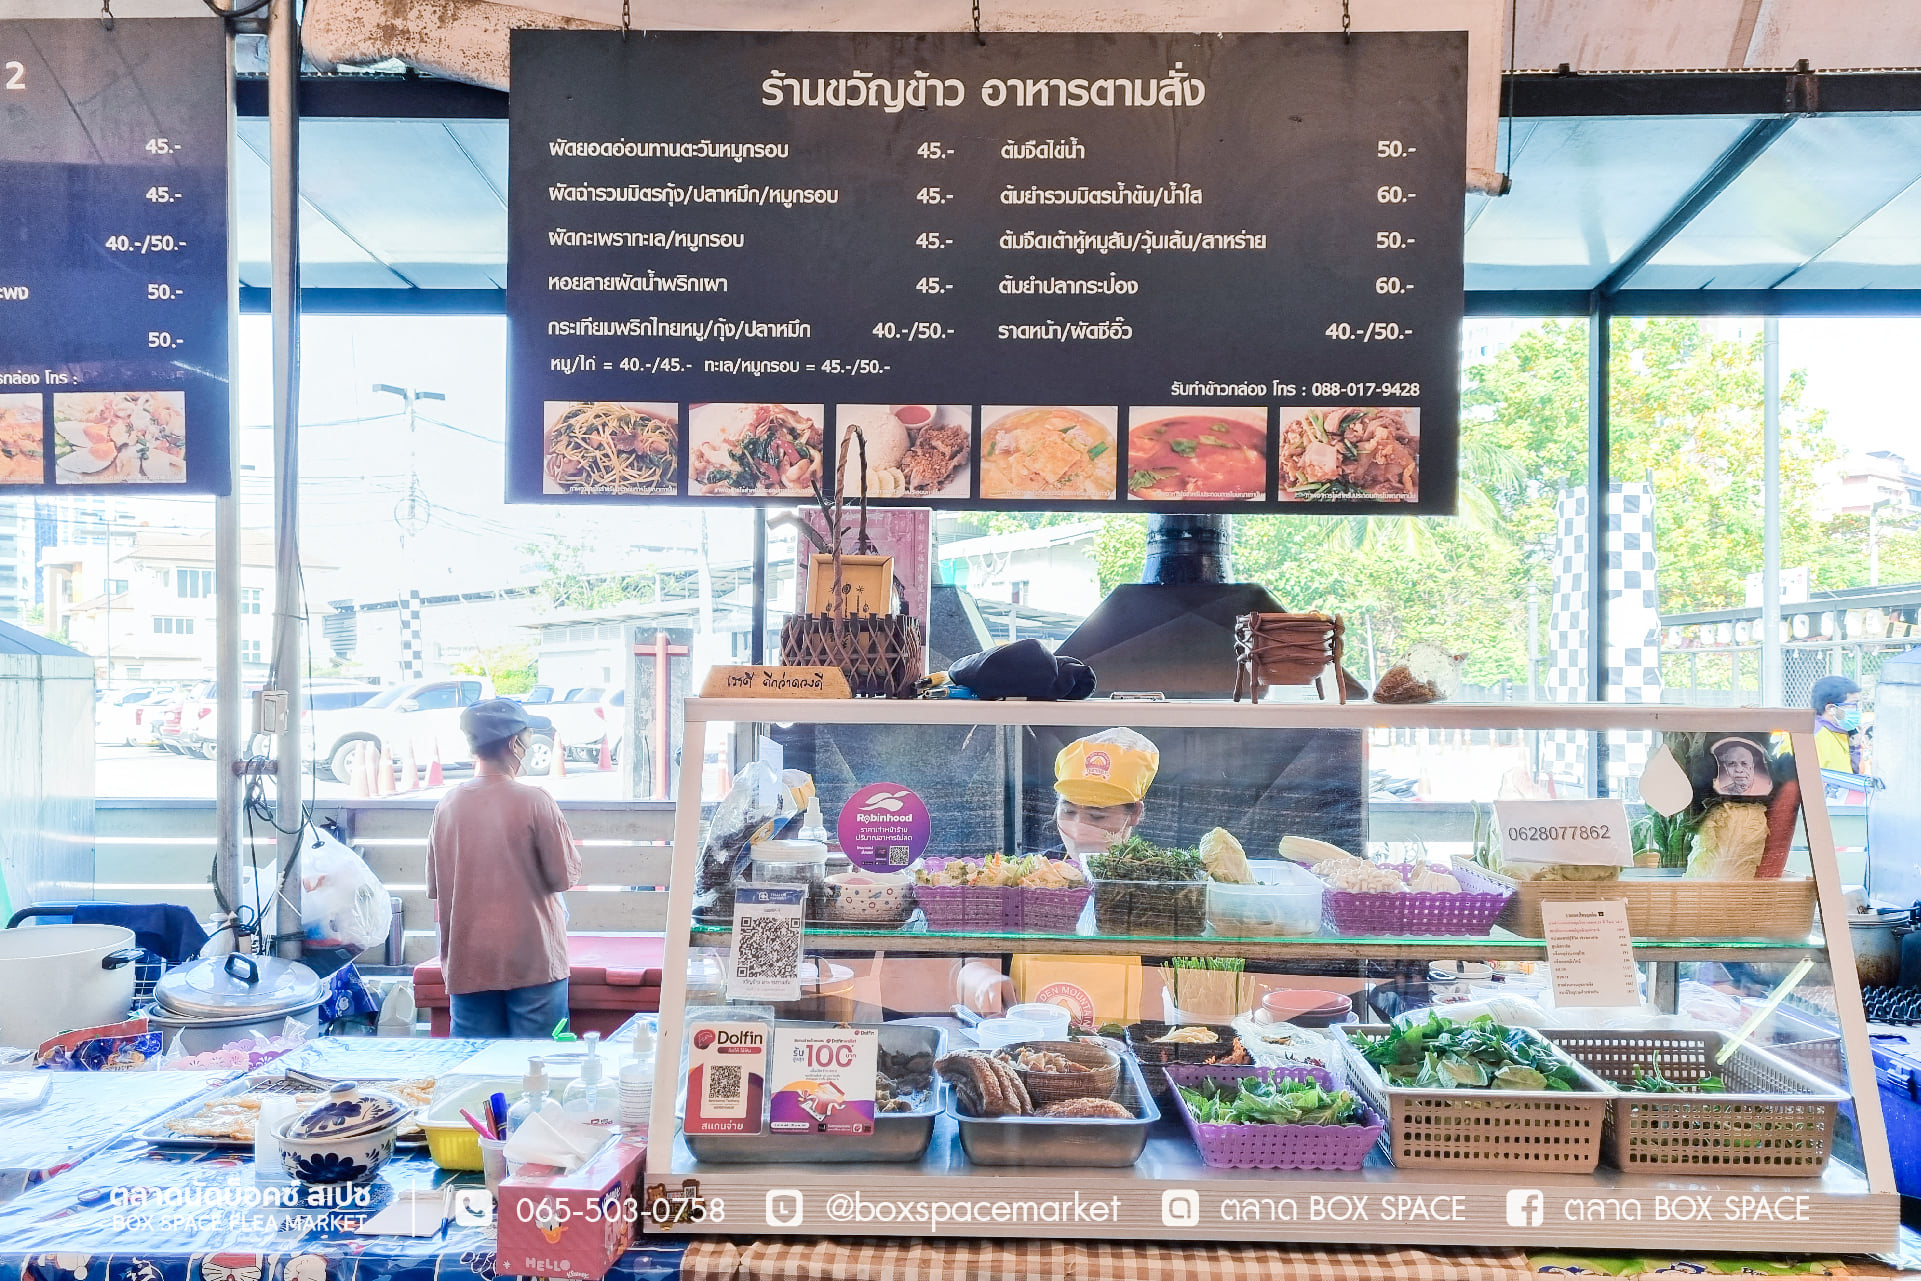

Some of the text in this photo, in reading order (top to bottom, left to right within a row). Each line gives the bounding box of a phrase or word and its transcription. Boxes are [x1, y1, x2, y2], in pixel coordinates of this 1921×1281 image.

[5, 60, 26, 90] 2
[761, 60, 1207, 114] ร้านขวัญข้าว อาหารตามสั่ง
[145, 138, 183, 156] 45.-
[548, 137, 956, 163] ผัดยอดอ่อนทานตะวันหมูกรอบ 45.-
[1000, 136, 1418, 160] ต้มจืดไข่น้ำ 50.-
[145, 186, 183, 204] 45.-
[548, 182, 955, 209] ผัดฉ่ารวมมิตรกุ้ง/ปลาหมึก/หมูกรอบ 45.-
[1000, 181, 1418, 208] ต้มยำรวมมิตรน้ำข้น/น้ำใส 60.-
[105, 234, 188, 255] 40.-/50.-
[548, 227, 954, 252] ผัดกะเพราทะเล/หมูกรอบ 45.-
[999, 229, 1417, 255] ต้มจืดเต้าหู้หมูสับ/วุ้นเส้น/สาหร่าย 50.-
[146, 283, 185, 301] 50.-
[548, 269, 955, 295] หอยลายผัดน้ำพริกเผา 45.-
[998, 271, 1416, 296] ต้มยำปลากระป๋อง 60.-
[547, 316, 956, 343] กระเทียมพริกไทยหมู/กุ้ง/ปลาหมึก 40.-/50.-
[1324, 322, 1415, 344] 40.-/50.-
[147, 331, 185, 350] 50.-
[550, 355, 597, 376] หมู/ไก่
[618, 357, 693, 375] 40.-/45.-
[704, 357, 801, 378] ทะเล/หมูกรอบ
[820, 359, 892, 377] 45.-/50.-
[43, 369, 69, 386] โทร
[1170, 379, 1268, 398] รับทำข้าวกล่อง
[1271, 379, 1298, 398] โทร
[1310, 381, 1421, 398] 088-017-9428
[856, 813, 913, 824] Robinhood
[1508, 825, 1611, 841] 0628077862
[1040, 986, 1059, 1002] DEN
[717, 1030, 763, 1045] Dolfin
[701, 1121, 744, 1130] สแกนจ่าย
[525, 1257, 571, 1272] HELLO
